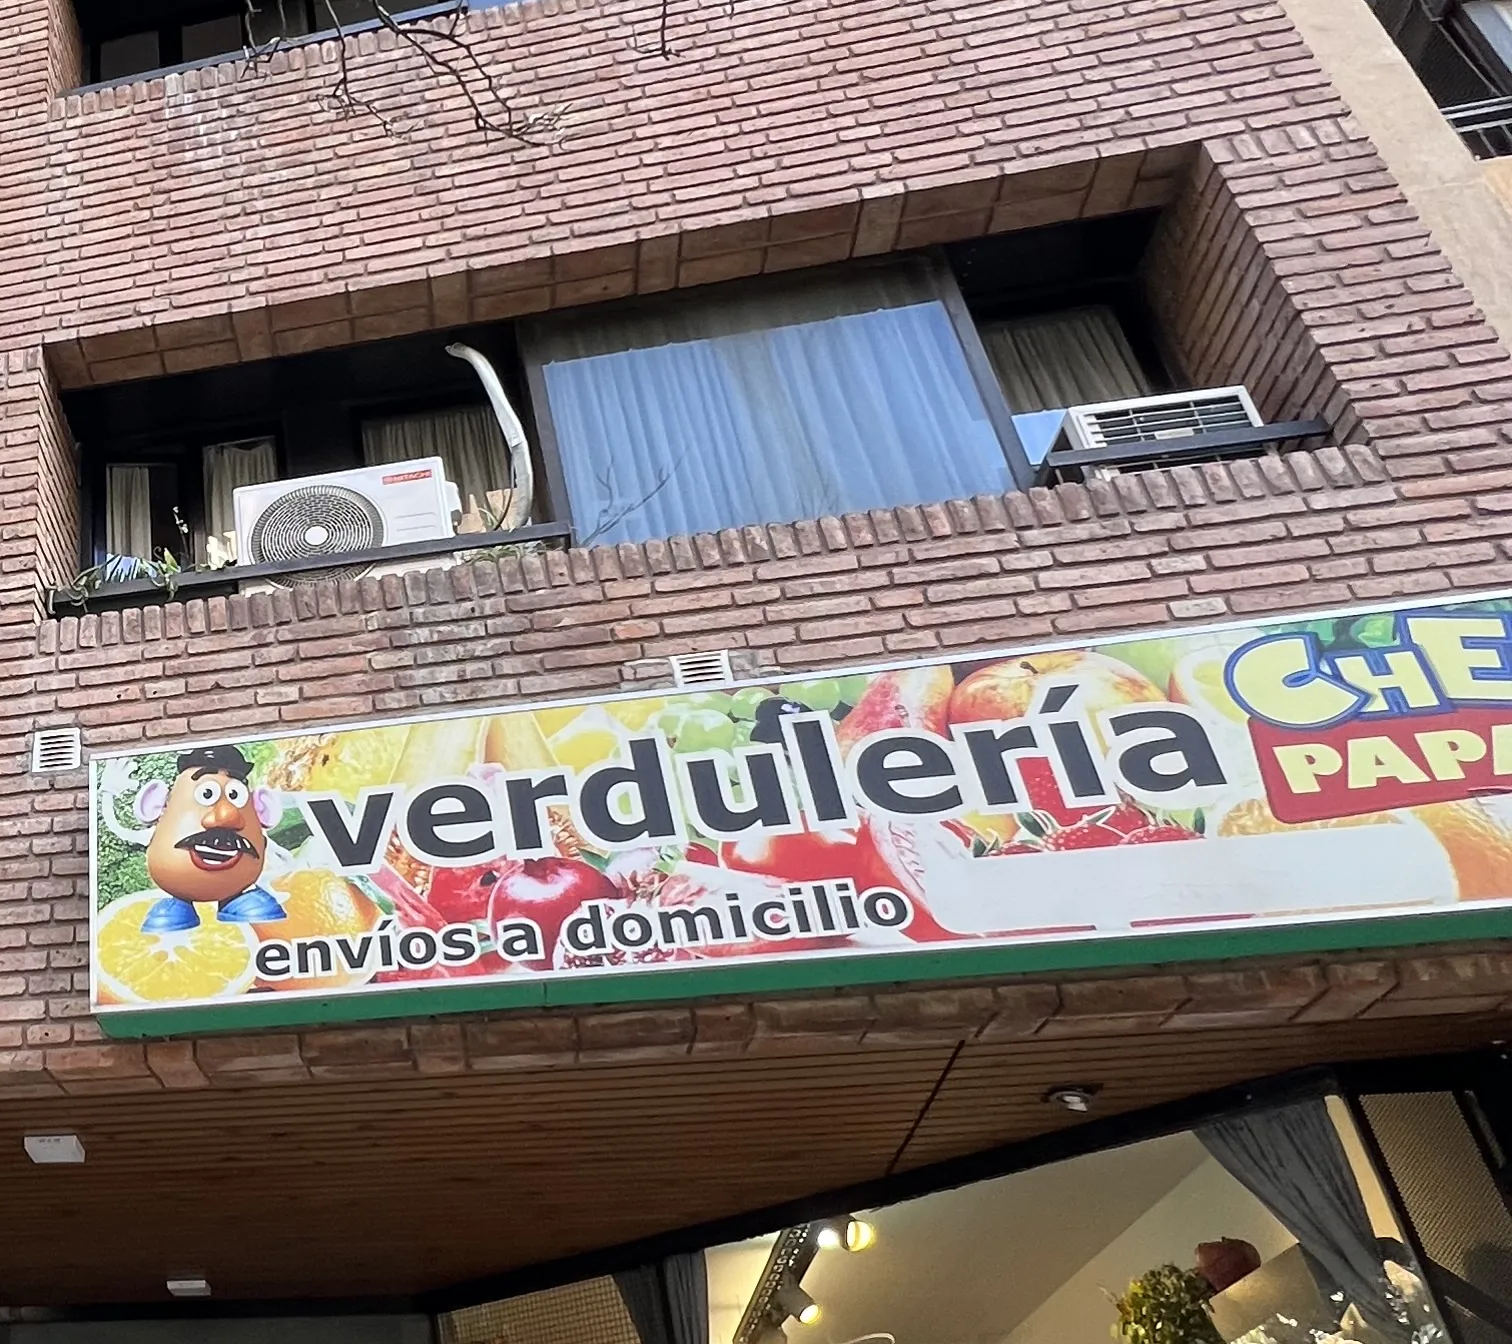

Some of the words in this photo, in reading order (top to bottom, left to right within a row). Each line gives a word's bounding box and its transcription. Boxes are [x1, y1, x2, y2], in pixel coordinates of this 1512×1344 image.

[1226, 611, 1512, 728] CHE
[307, 684, 1228, 868] verdulería
[1271, 724, 1512, 795] PAP
[256, 919, 476, 975] envíos
[501, 924, 540, 959] a
[566, 884, 909, 954] domicilio
